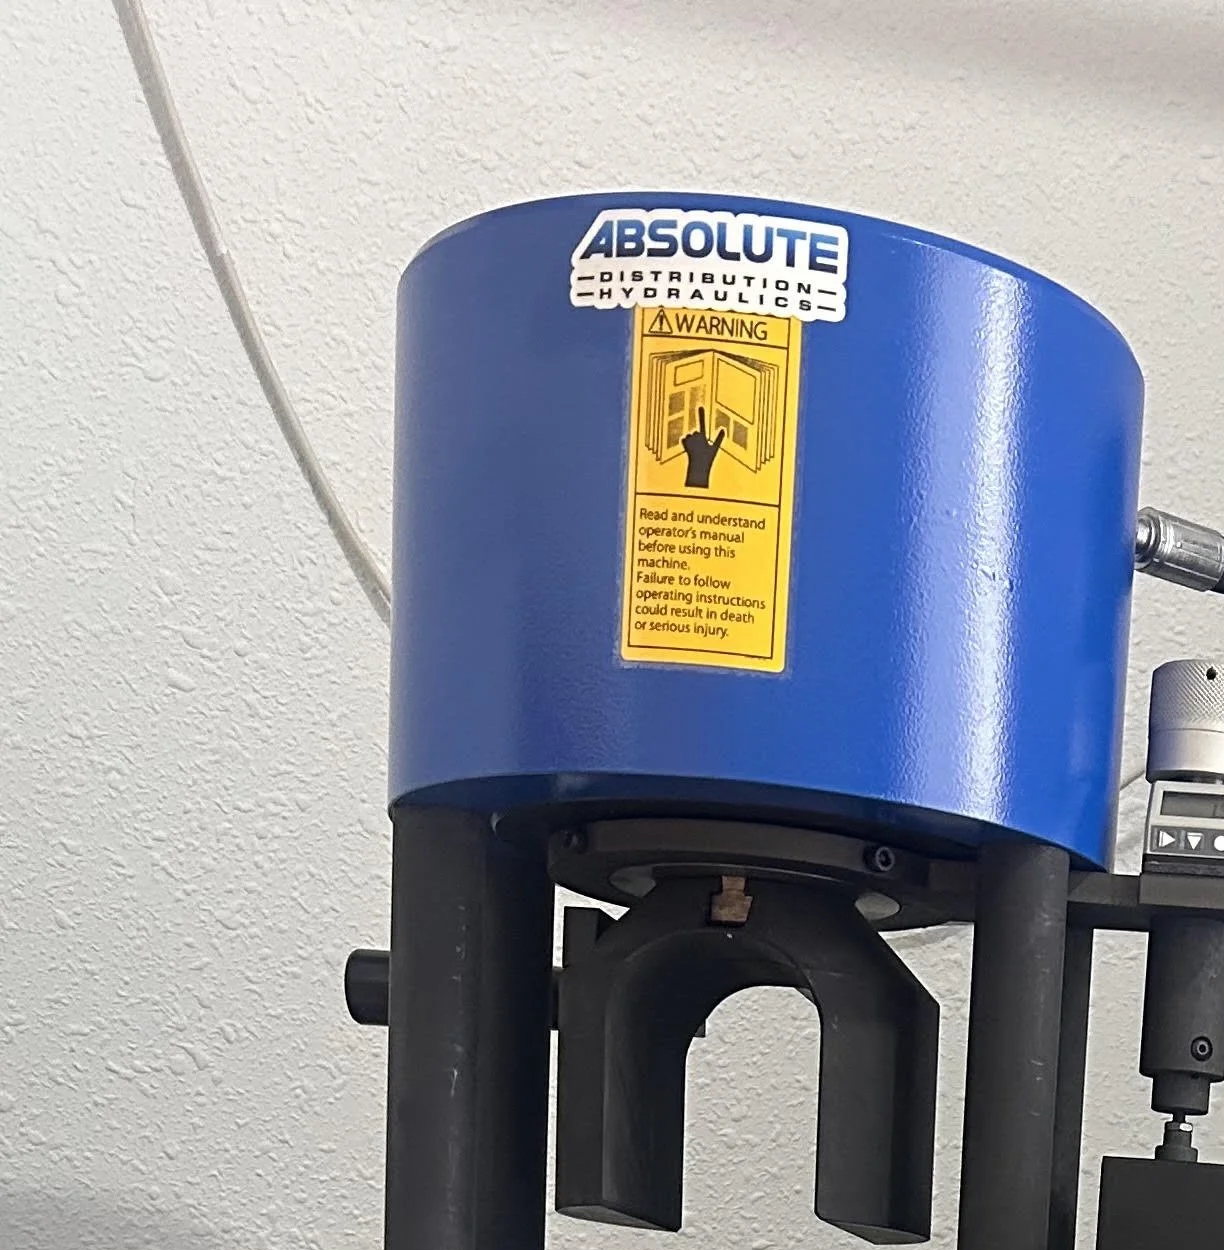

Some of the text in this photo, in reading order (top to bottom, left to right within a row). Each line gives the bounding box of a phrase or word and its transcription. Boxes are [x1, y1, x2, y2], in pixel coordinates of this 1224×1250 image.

[579, 218, 839, 274] ABSOLUTE
[599, 270, 812, 295] DISTRIBUTION
[599, 287, 812, 311] HYDRAULICS
[675, 313, 768, 341] WARNING
[639, 507, 766, 530] Read and understand
[700, 530, 745, 543] manual
[638, 540, 736, 559] before using this
[637, 557, 690, 571] machine.
[636, 571, 731, 590] Failure to follow
[636, 589, 766, 610] operating instructions
[635, 604, 755, 624] could result in death
[634, 620, 730, 640] or serious injury.
